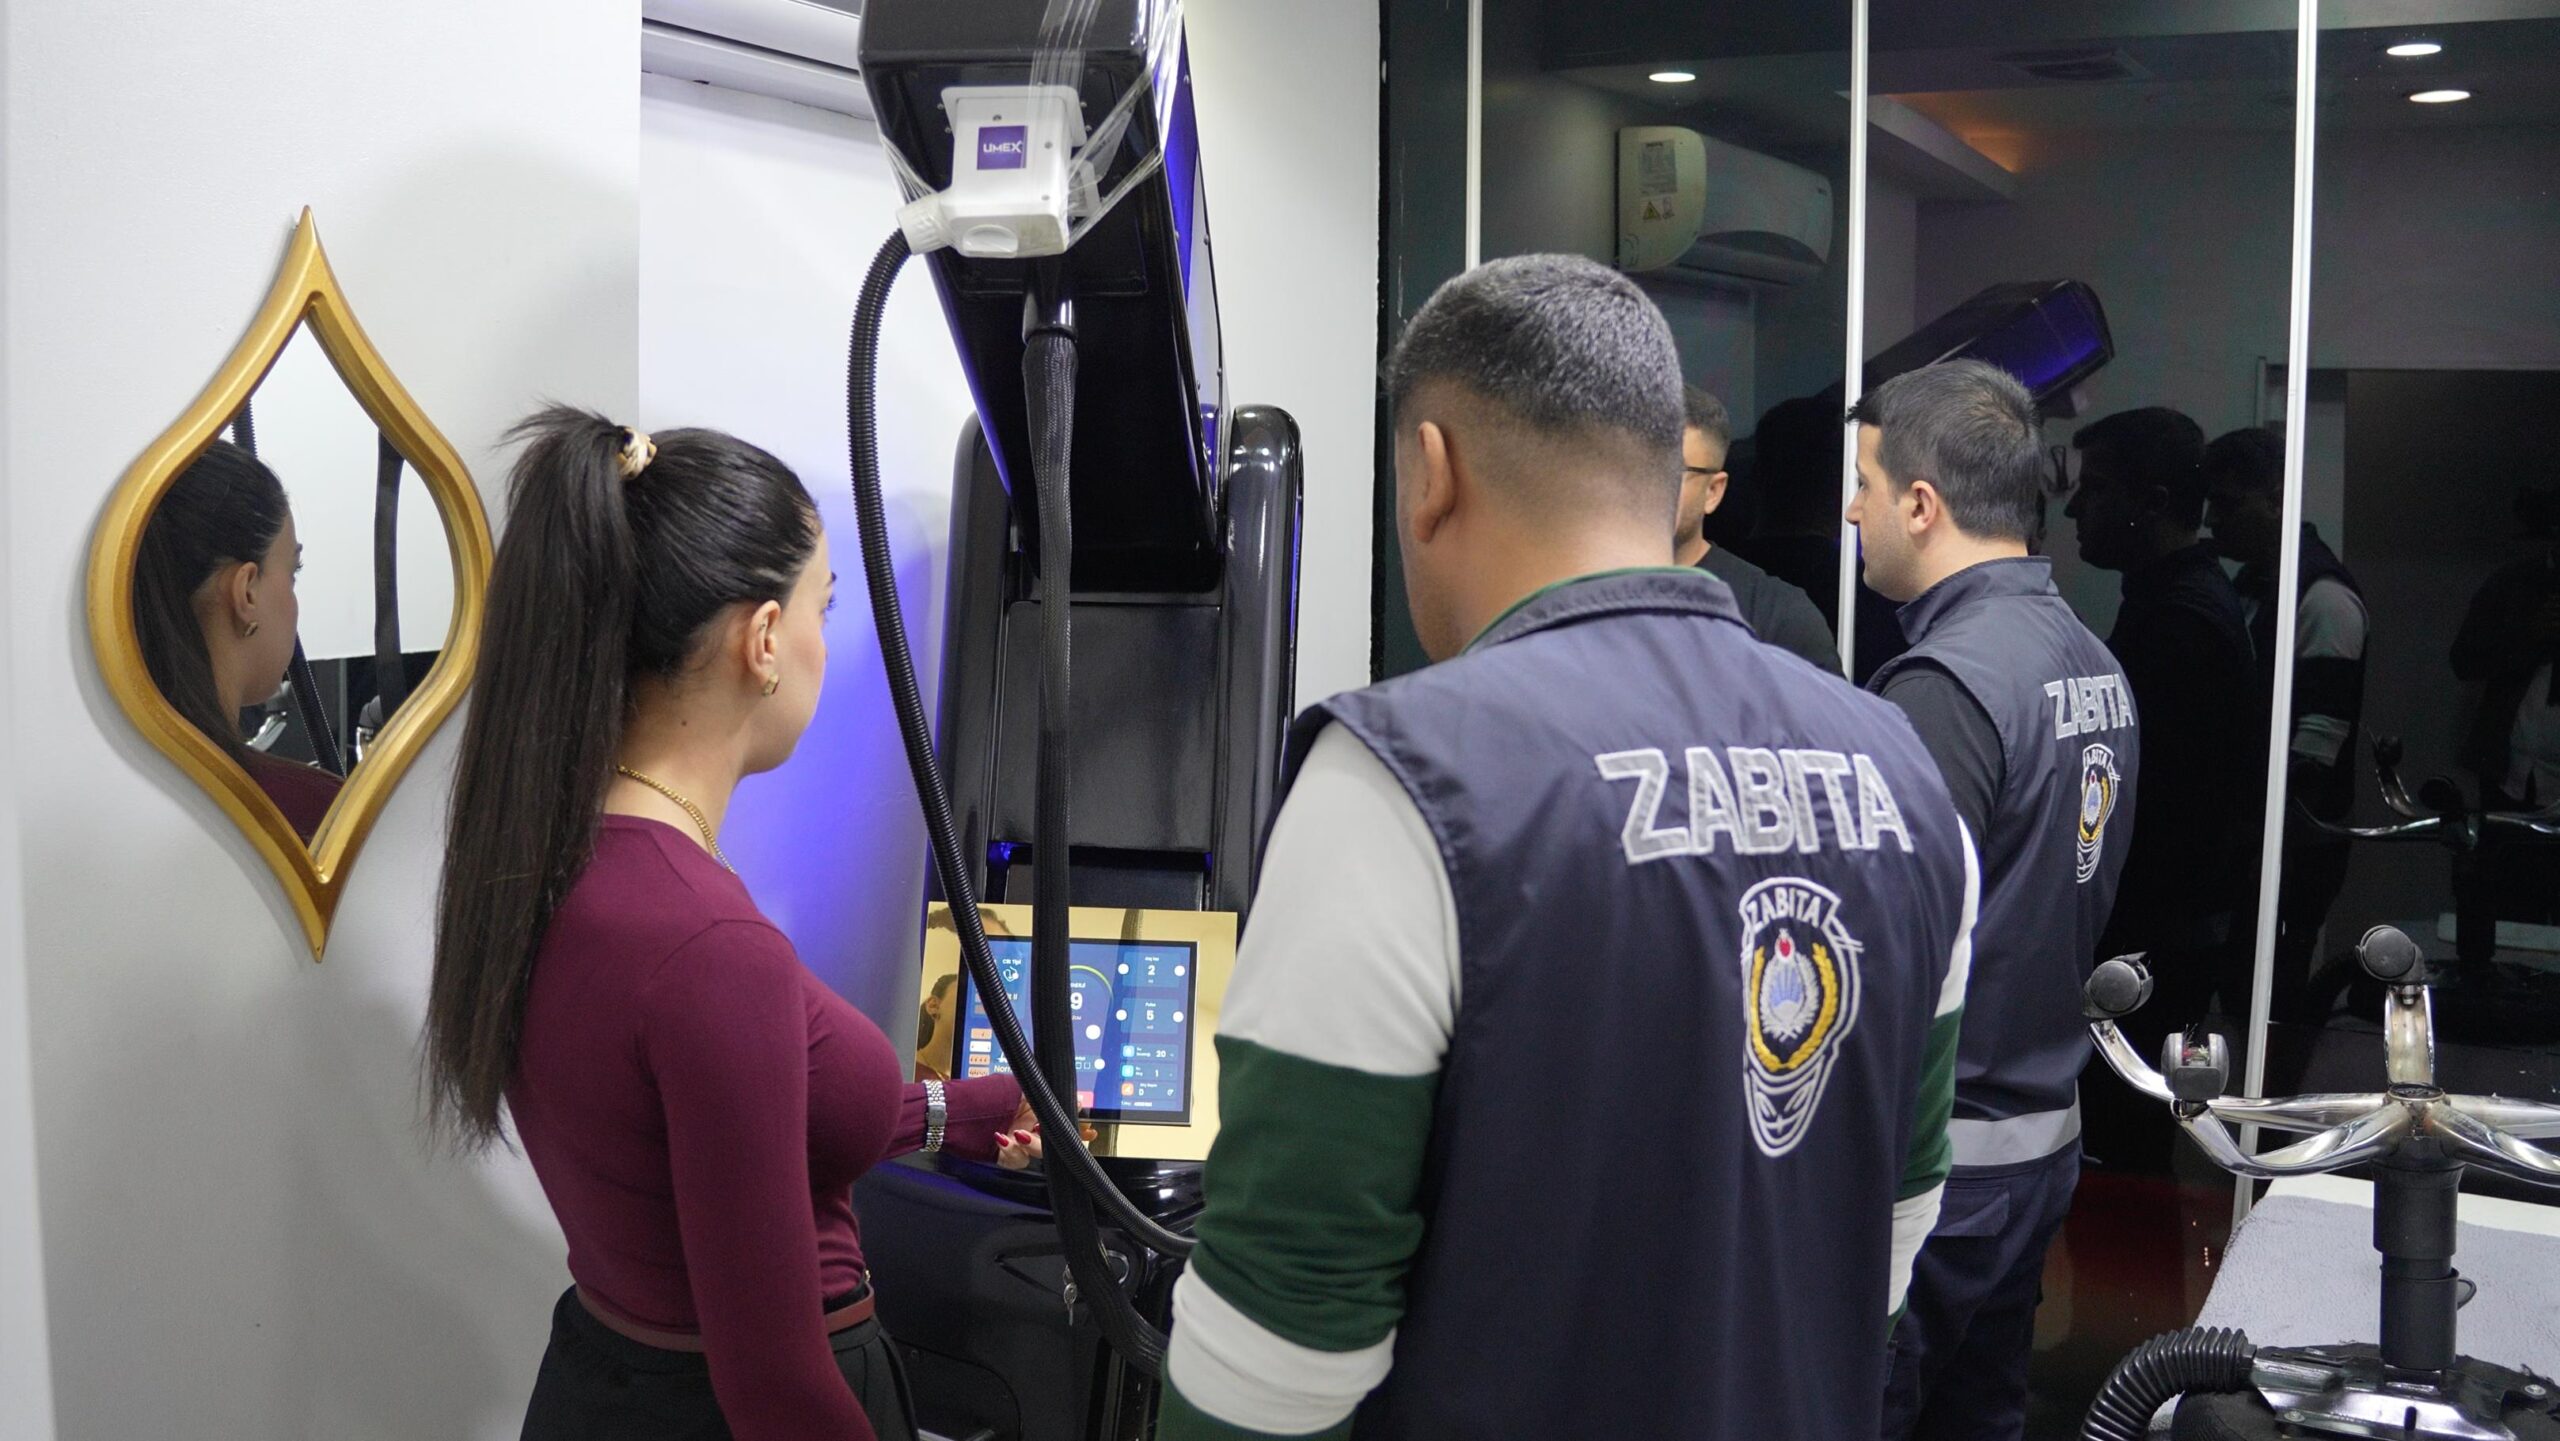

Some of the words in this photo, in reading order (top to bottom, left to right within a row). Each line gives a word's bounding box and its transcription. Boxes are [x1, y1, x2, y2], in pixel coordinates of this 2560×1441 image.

[983, 140, 1022, 153] UMEX
[2043, 673, 2135, 740] ZABITA
[1594, 746, 1914, 865] ZABITA
[1746, 886, 1821, 935] ZABITA
[1147, 965, 1156, 976] 2
[1146, 1009, 1155, 1021] 5
[1155, 1050, 1167, 1058] 20
